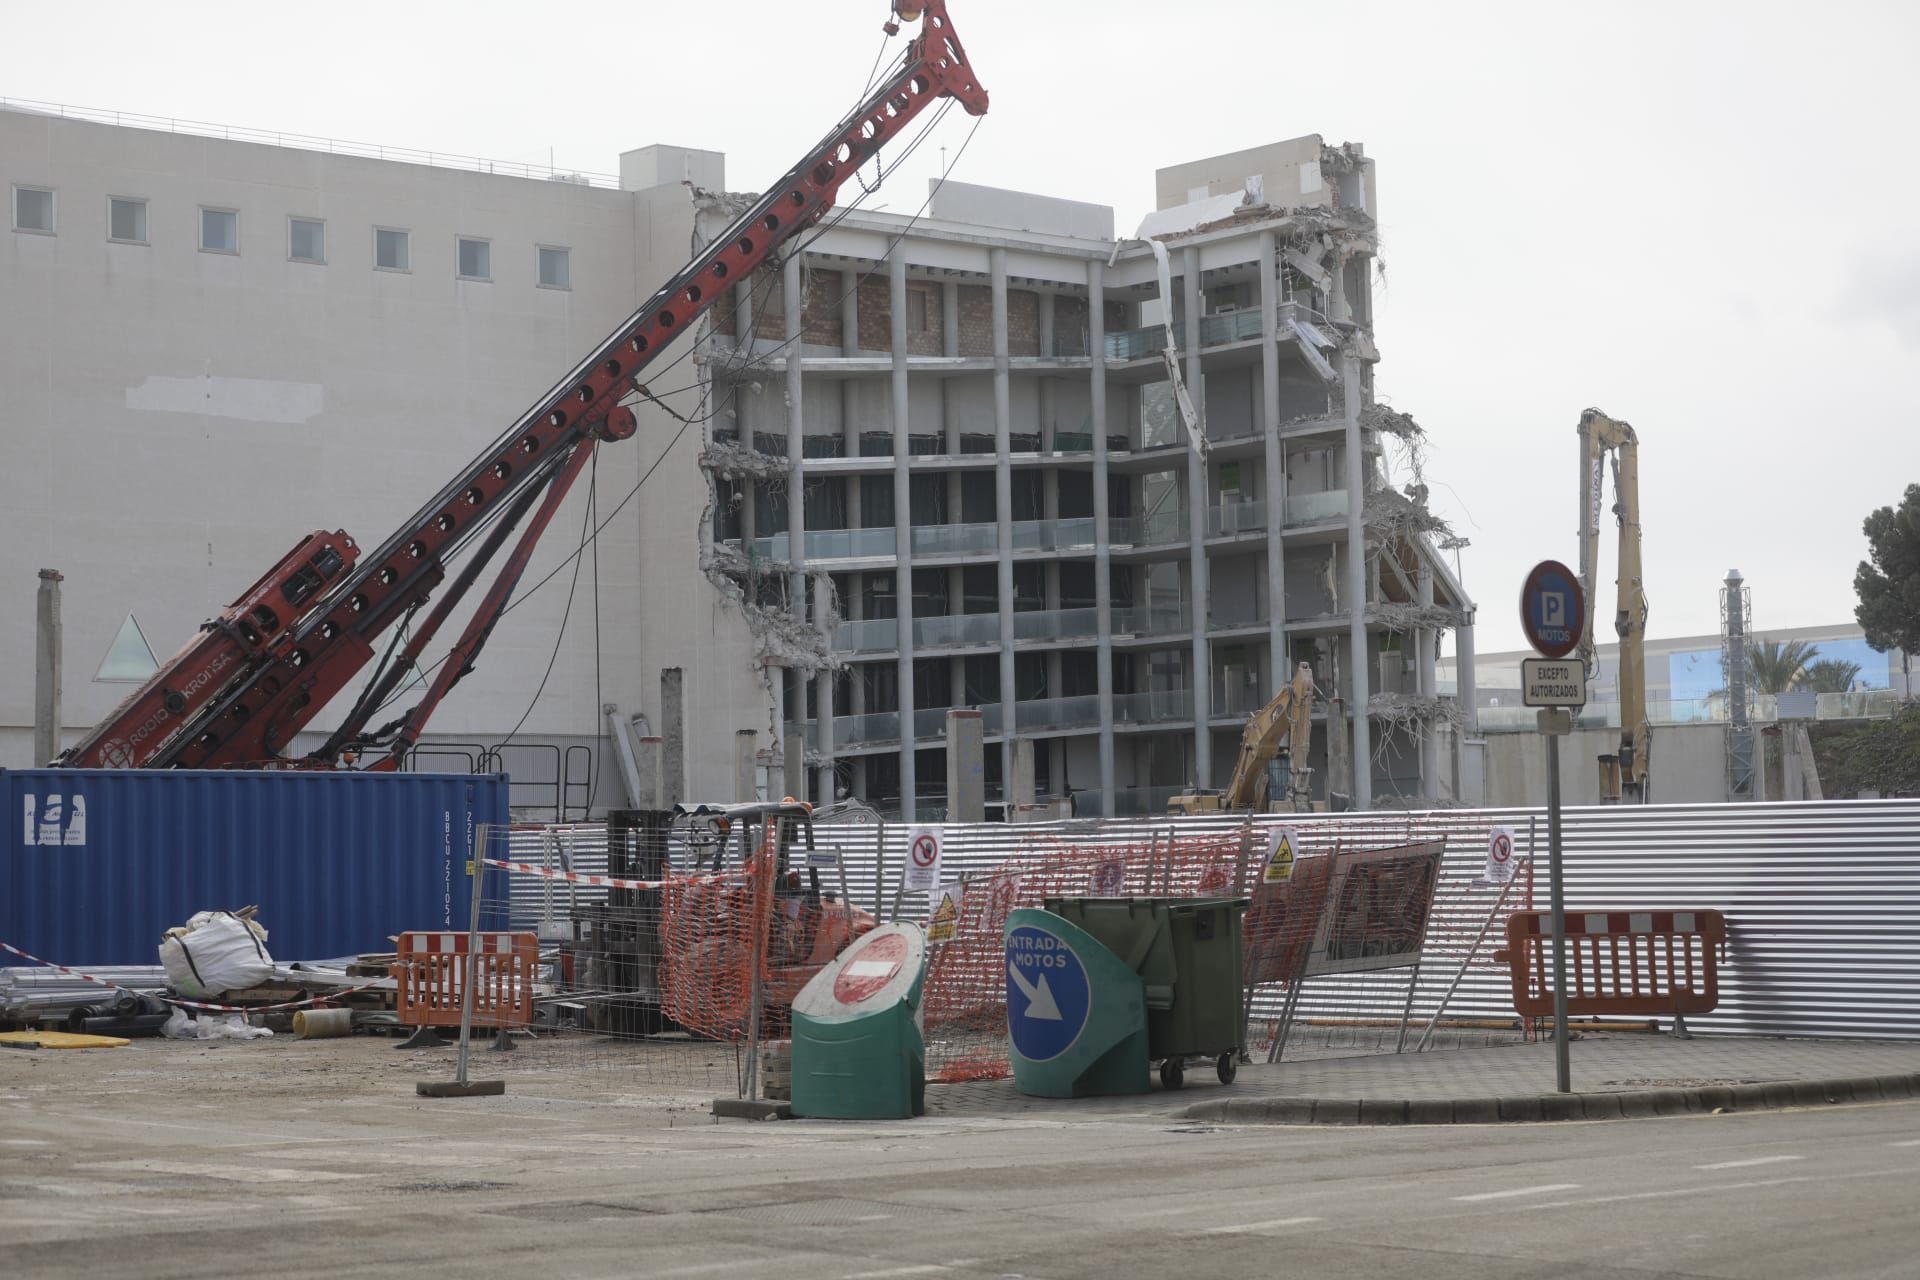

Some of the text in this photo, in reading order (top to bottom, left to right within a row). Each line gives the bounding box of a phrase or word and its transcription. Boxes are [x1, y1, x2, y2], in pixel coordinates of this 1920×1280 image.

[1546, 596, 1560, 622] P
[1538, 629, 1571, 642] MOTOS
[1537, 667, 1569, 681] EXCEPTO
[1530, 684, 1578, 698] AUTORIZADOS
[1015, 953, 1067, 968] MOTOS
